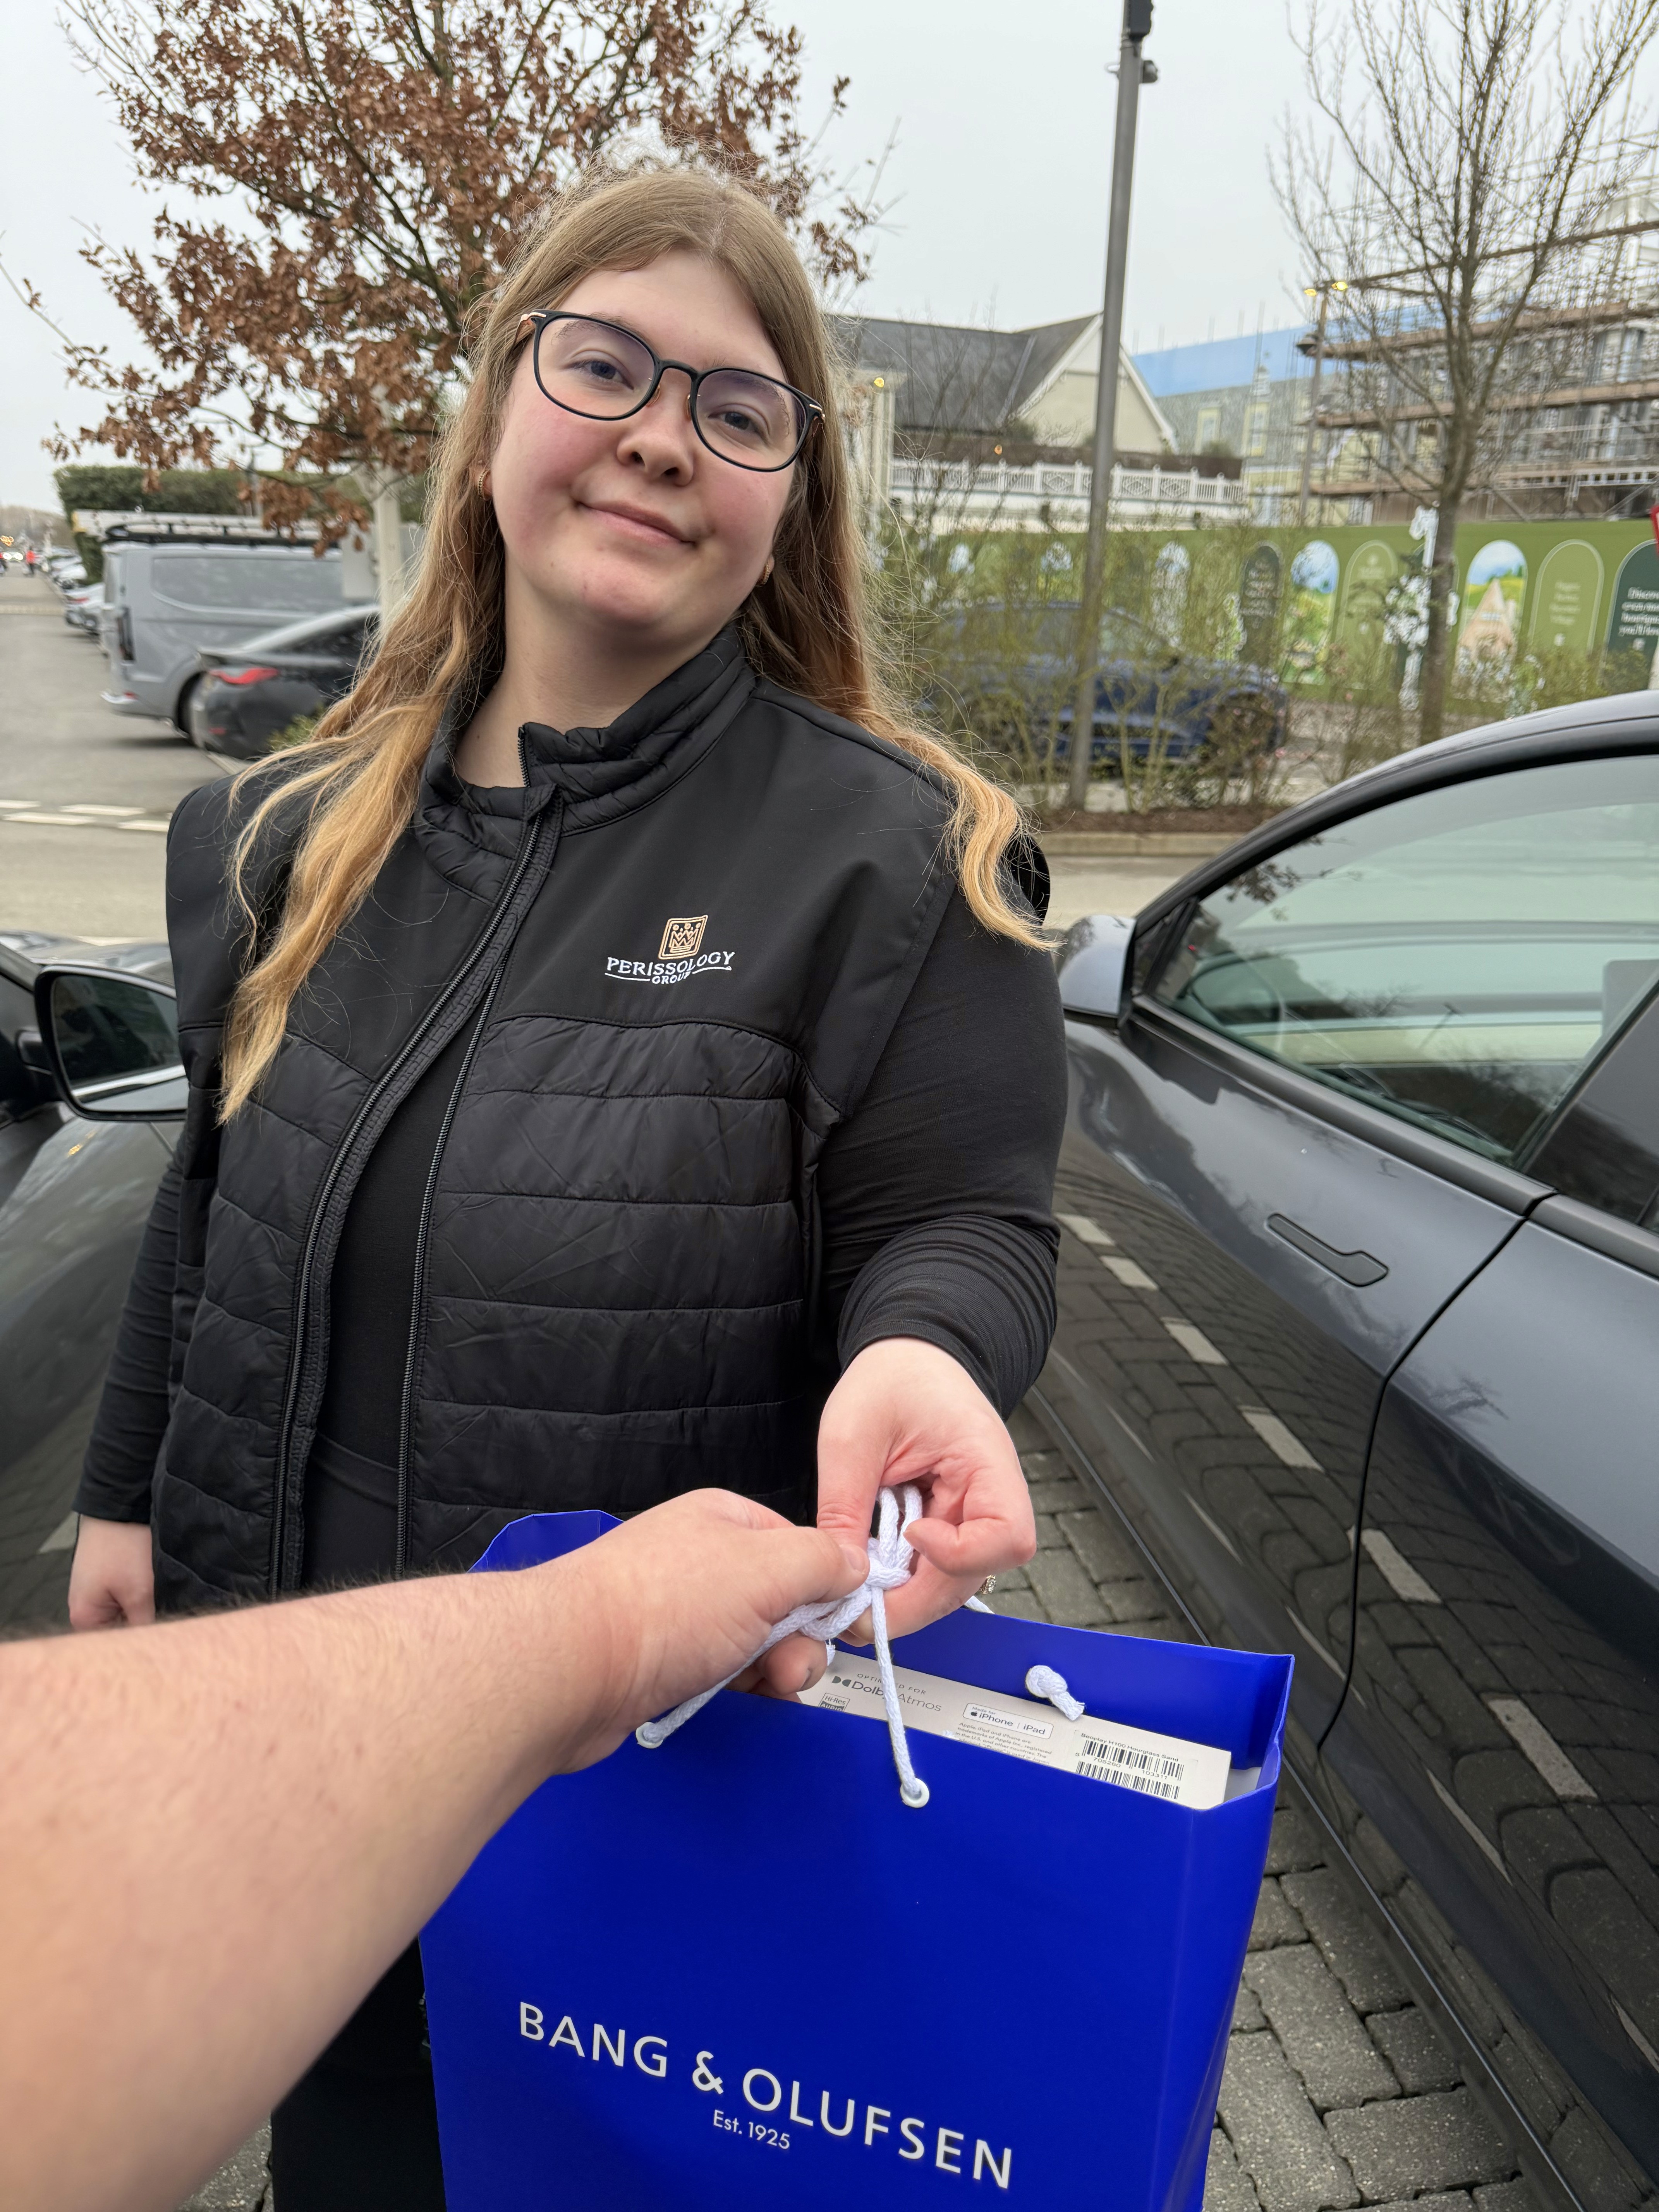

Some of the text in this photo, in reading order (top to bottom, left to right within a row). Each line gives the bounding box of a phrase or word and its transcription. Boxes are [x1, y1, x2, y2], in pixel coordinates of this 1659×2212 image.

[606, 951, 735, 976] PERISSOLOGY
[651, 971, 690, 984] GROUP
[852, 1681, 942, 1711] Dolb Atmos
[857, 1673, 926, 1695] OPTID FOR
[824, 1695, 846, 1705] Hi-Res
[979, 1712, 1046, 1735] iPhone iPad
[957, 1727, 988, 1738] trademarks
[1024, 1745, 1052, 1755] registered
[1081, 1733, 1107, 1743] Beoplay
[1108, 1740, 1126, 1748] H100
[1127, 1745, 1160, 1757] Hourglass
[1094, 1757, 1121, 1768] 705260
[1142, 1770, 1167, 1779] 103311
[519, 2001, 1012, 2190] BANG & OLUFSEN
[712, 2109, 791, 2151] Est. 1925
